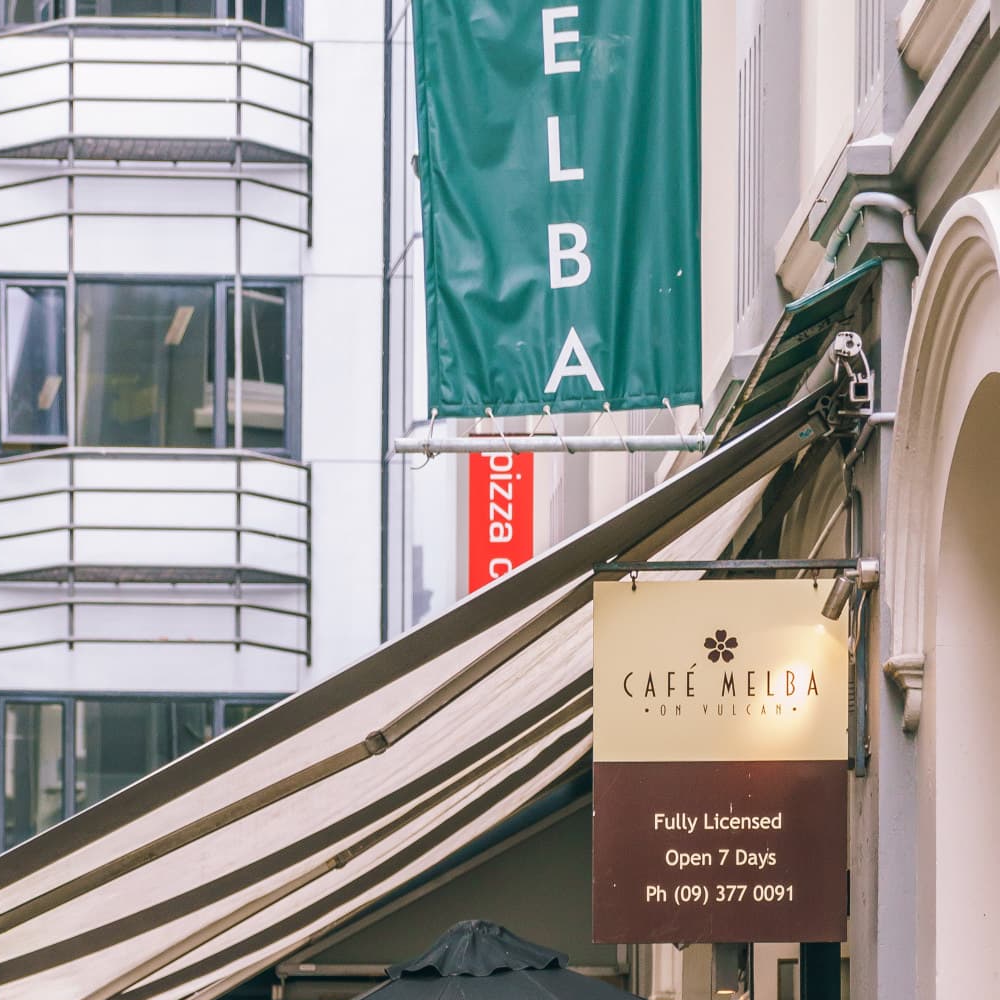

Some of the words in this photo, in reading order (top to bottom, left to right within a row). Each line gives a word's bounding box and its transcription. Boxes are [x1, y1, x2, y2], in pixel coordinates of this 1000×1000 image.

[481, 451, 522, 543] pizza
[623, 663, 697, 698] CAFÉ
[721, 669, 819, 697] MELBA
[660, 704, 681, 716] ON
[703, 703, 782, 716] VULCAN
[654, 812, 698, 834] Fully
[703, 812, 782, 830] Licensed
[665, 848, 712, 870] Open
[718, 849, 730, 866] 7
[735, 849, 777, 869] Days
[646, 885, 667, 902] Ph
[674, 885, 709, 905] (09)
[715, 885, 747, 902] 377
[753, 885, 794, 902] 0091
